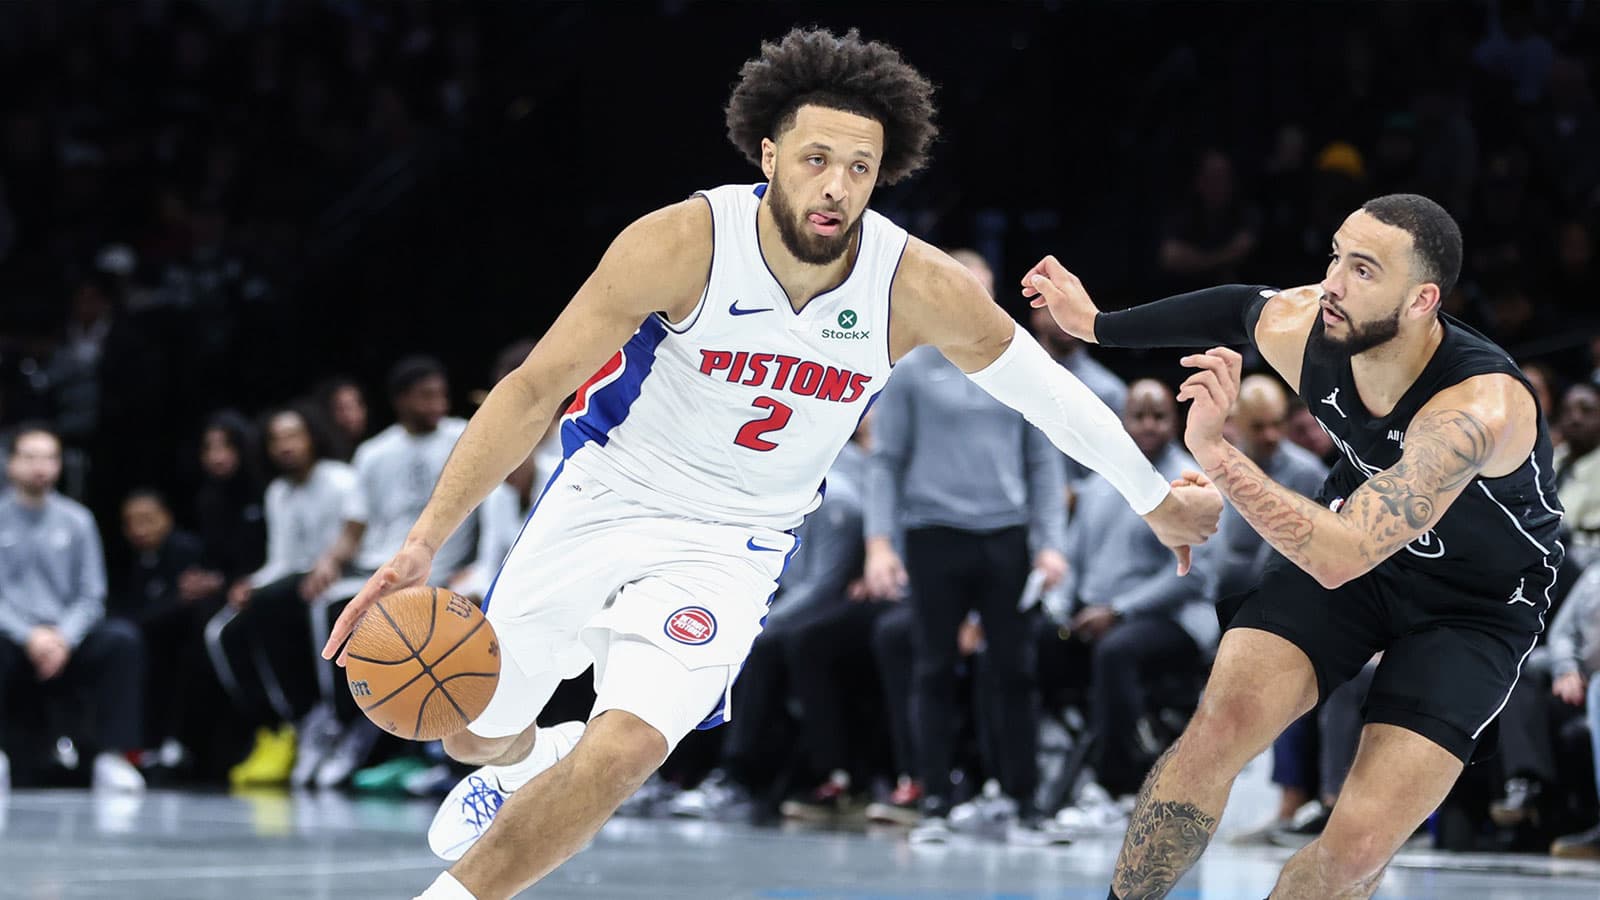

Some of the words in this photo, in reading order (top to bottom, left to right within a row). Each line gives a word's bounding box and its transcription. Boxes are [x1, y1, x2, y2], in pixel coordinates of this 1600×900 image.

[821, 328, 871, 340] StockX
[700, 349, 872, 403] PISTONS
[733, 395, 794, 453] 2
